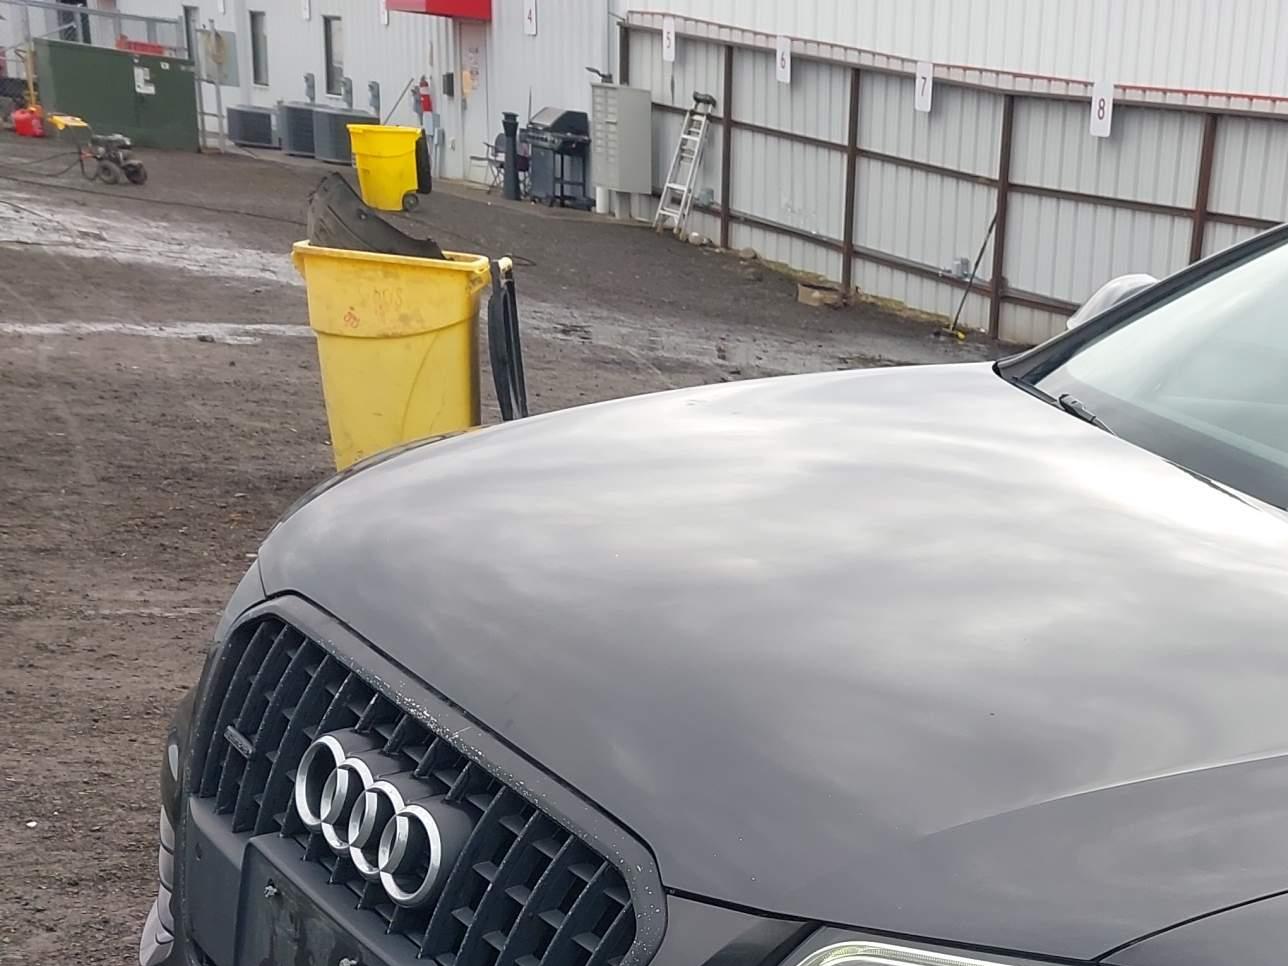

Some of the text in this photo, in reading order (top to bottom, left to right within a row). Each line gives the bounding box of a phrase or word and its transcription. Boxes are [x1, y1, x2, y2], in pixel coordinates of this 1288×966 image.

[667, 27, 671, 48] 5
[780, 52, 786, 69] 6
[920, 78, 928, 97] 7
[1096, 99, 1106, 121] 8
